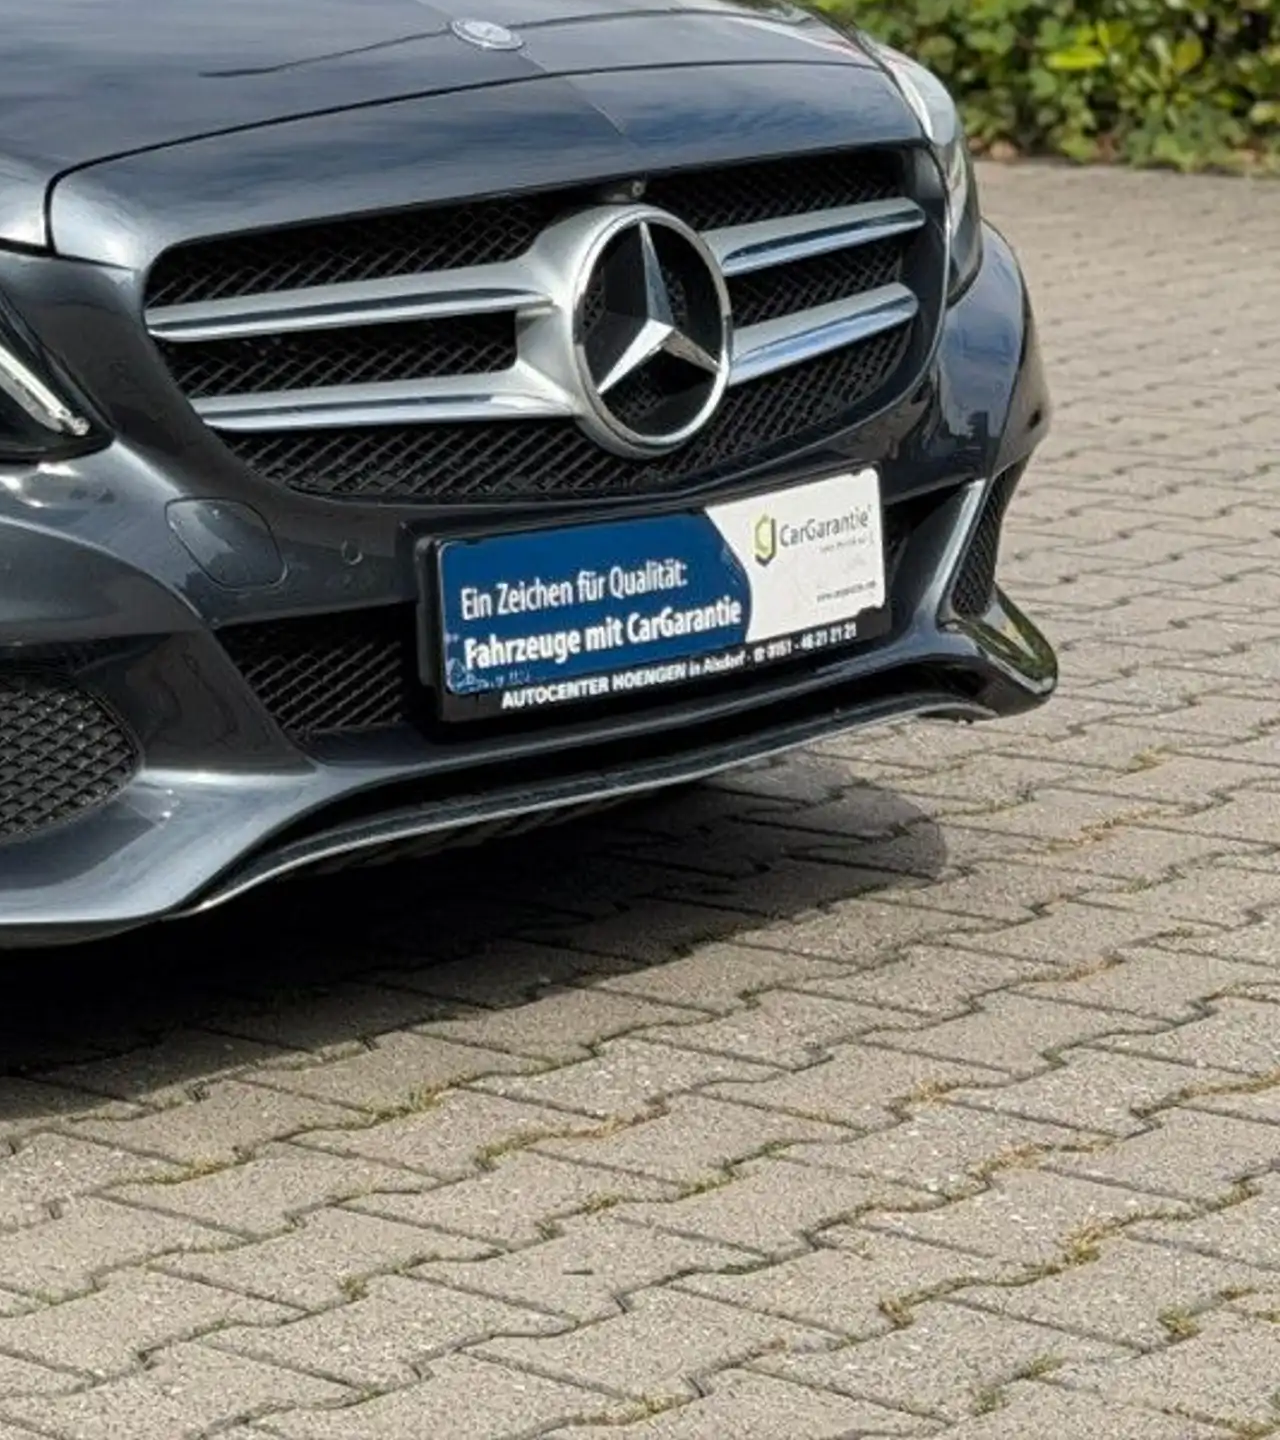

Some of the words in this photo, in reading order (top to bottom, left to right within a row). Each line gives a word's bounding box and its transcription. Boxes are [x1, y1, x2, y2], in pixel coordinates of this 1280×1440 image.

[779, 505, 869, 547] CarGarantie
[461, 587, 491, 620] Ein
[496, 576, 572, 615] Zeichen
[576, 569, 607, 603] für
[609, 558, 689, 600] Qualität:
[464, 629, 581, 670] Fahrzeuge
[585, 615, 624, 651] mit
[627, 594, 742, 644] CarGarantie
[501, 675, 610, 709] AUTOCENTER
[612, 662, 688, 692] HOENGEN
[690, 662, 701, 677] in
[704, 650, 747, 673] Alsdorf
